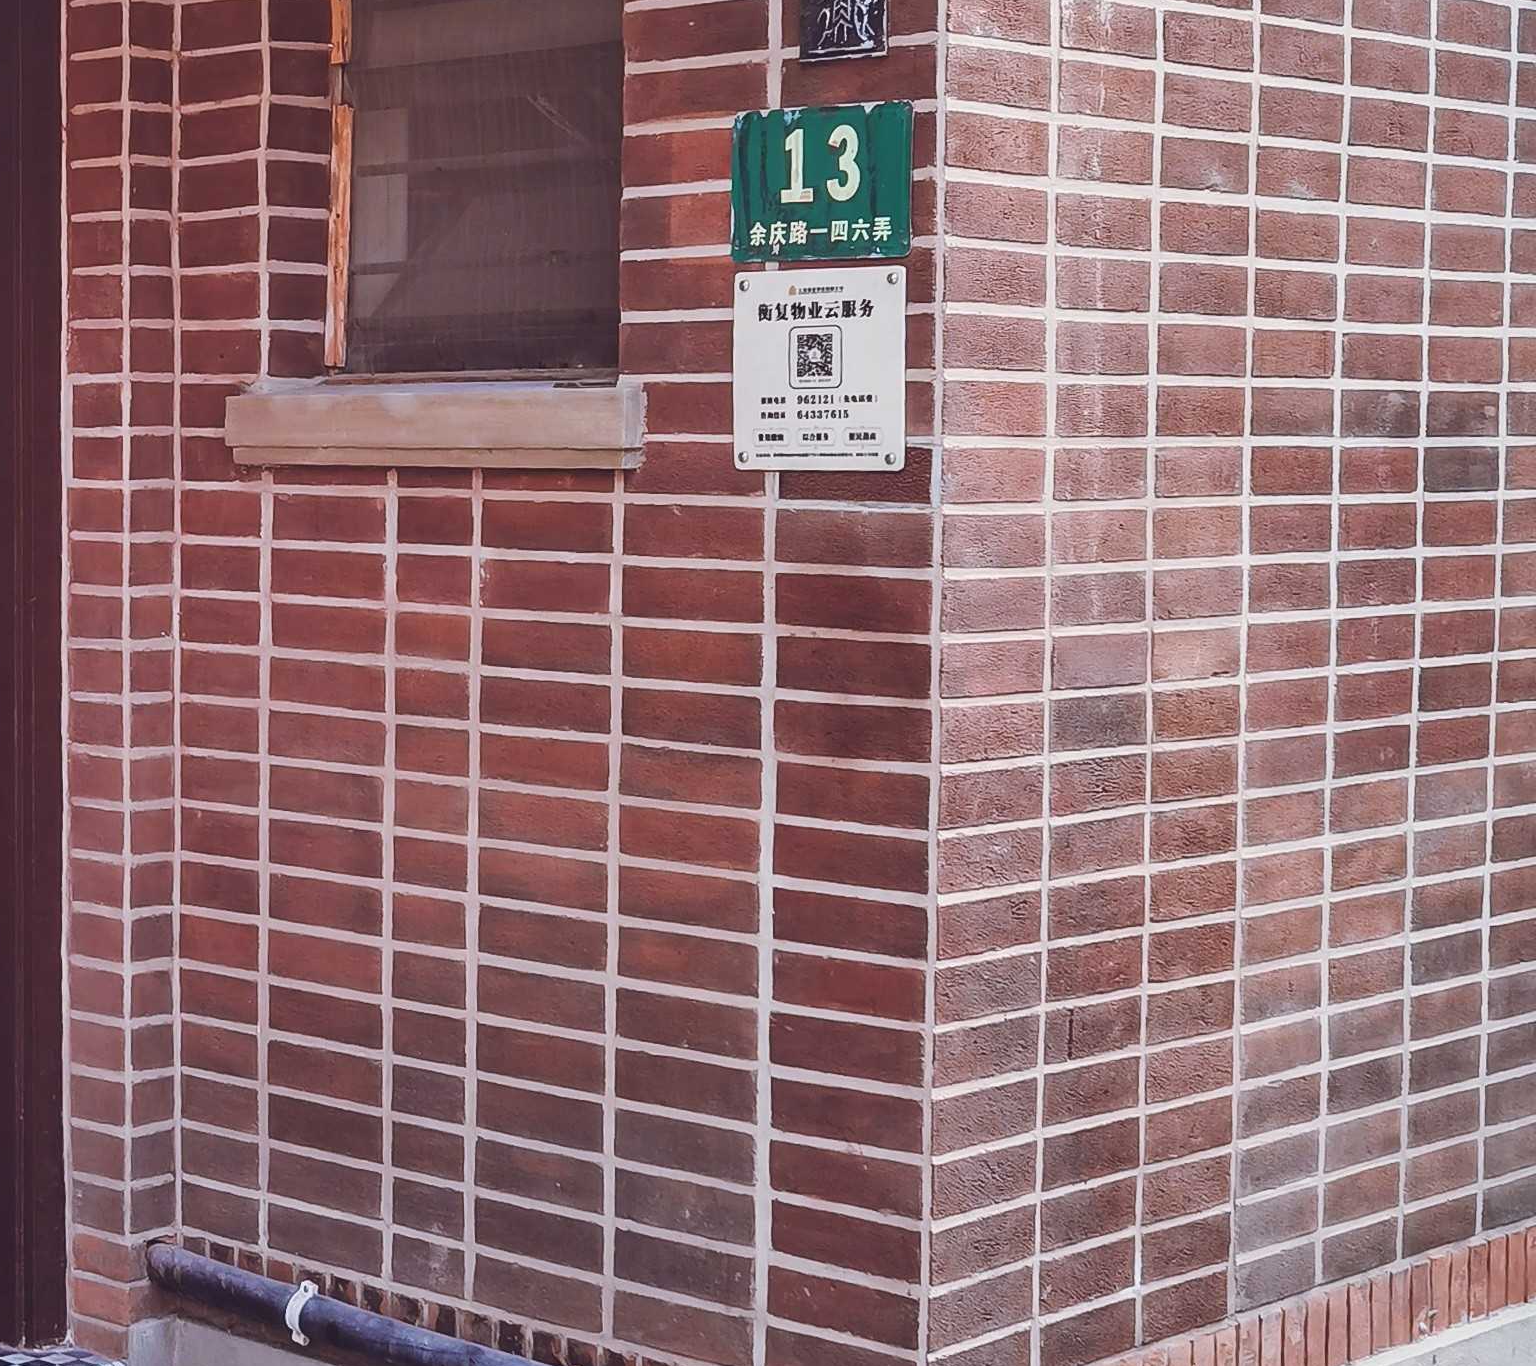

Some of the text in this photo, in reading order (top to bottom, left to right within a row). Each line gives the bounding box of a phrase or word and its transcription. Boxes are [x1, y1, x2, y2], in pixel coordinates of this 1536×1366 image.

[780, 124, 861, 203] 13
[749, 217, 893, 247] 余庆路一四六弄
[758, 299, 875, 322] 衡复物业云服务
[797, 395, 835, 405] 962121
[796, 409, 850, 420] 64337615
